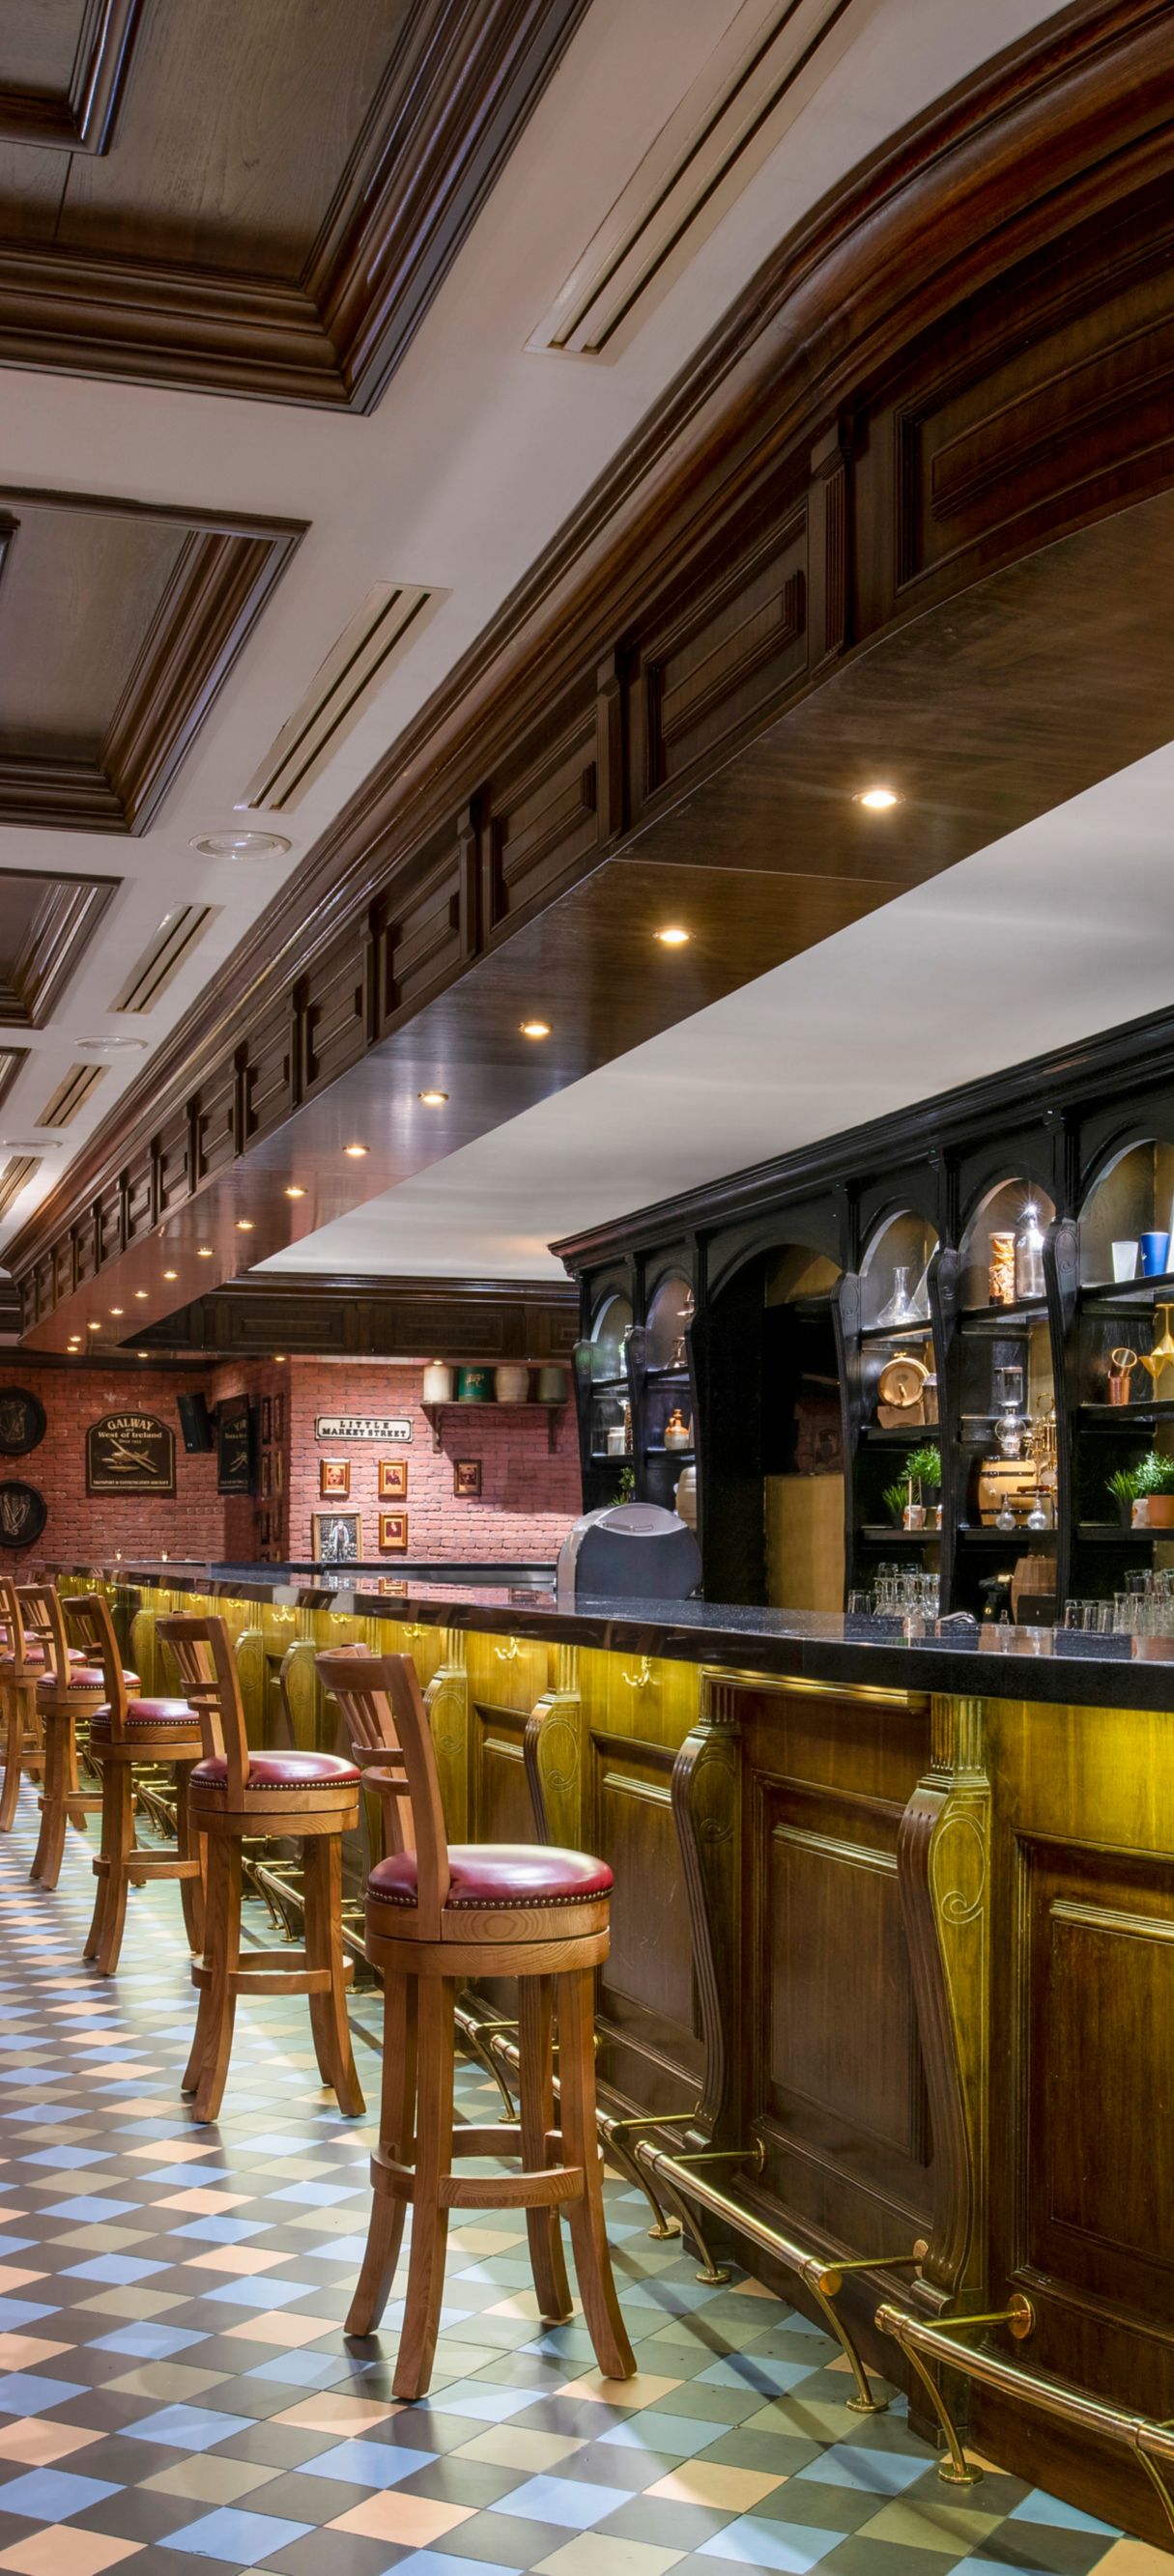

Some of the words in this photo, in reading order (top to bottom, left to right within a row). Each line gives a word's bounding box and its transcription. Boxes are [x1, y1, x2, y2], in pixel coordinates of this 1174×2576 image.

[107, 1418, 154, 1430] GALWAY
[340, 1420, 389, 1430] LITTLE
[322, 1428, 365, 1436] MARKET
